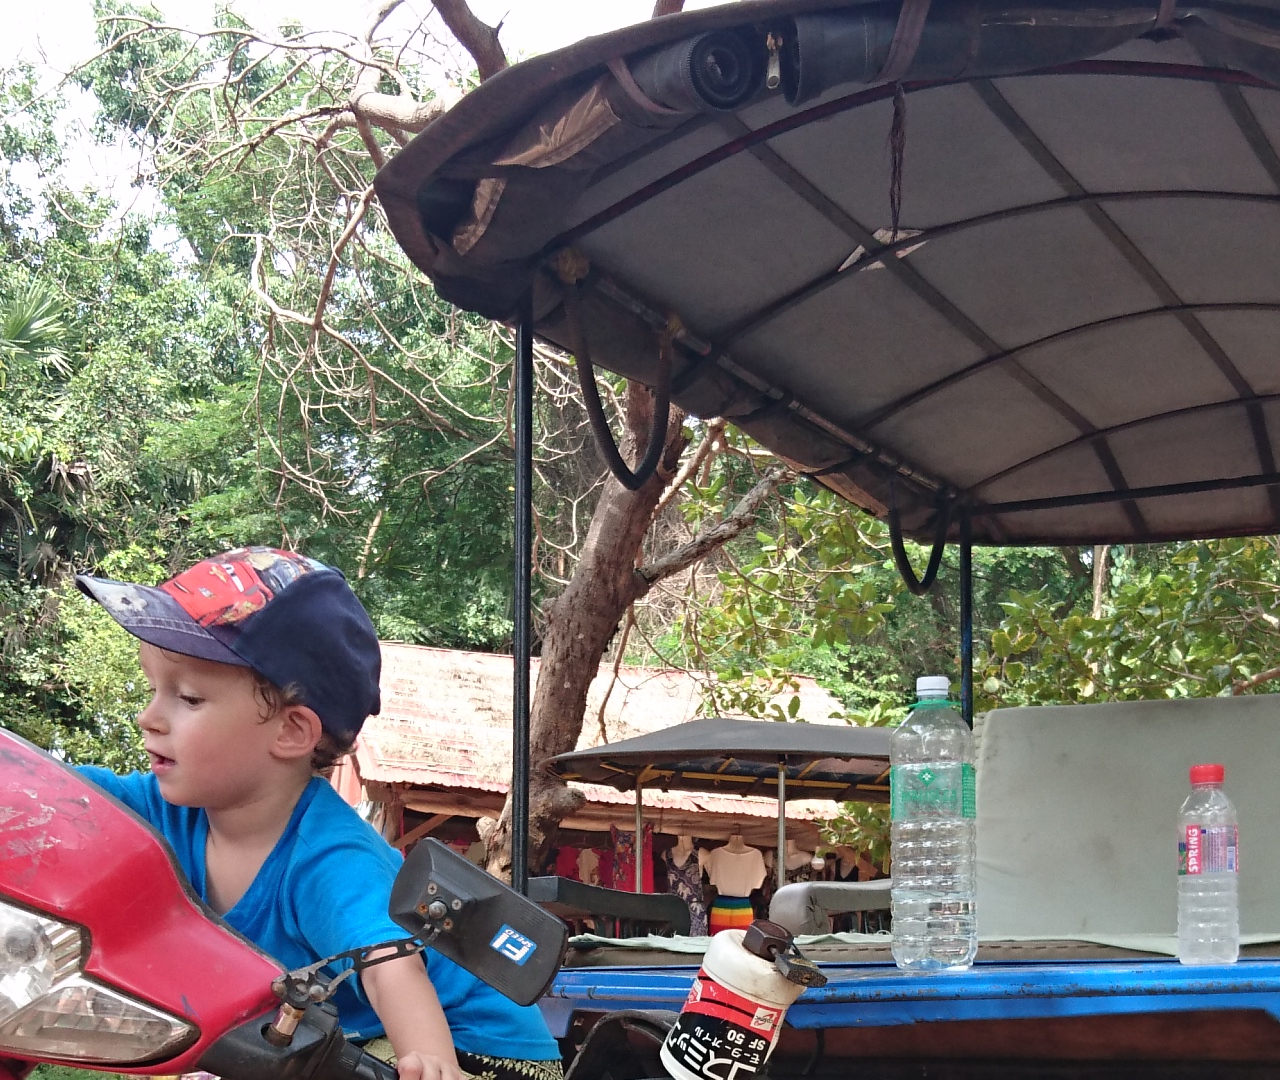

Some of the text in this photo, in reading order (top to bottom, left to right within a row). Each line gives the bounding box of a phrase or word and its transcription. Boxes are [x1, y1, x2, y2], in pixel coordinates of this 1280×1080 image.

[505, 929, 534, 948] SPEED
[726, 1029, 766, 1051] SF 50
